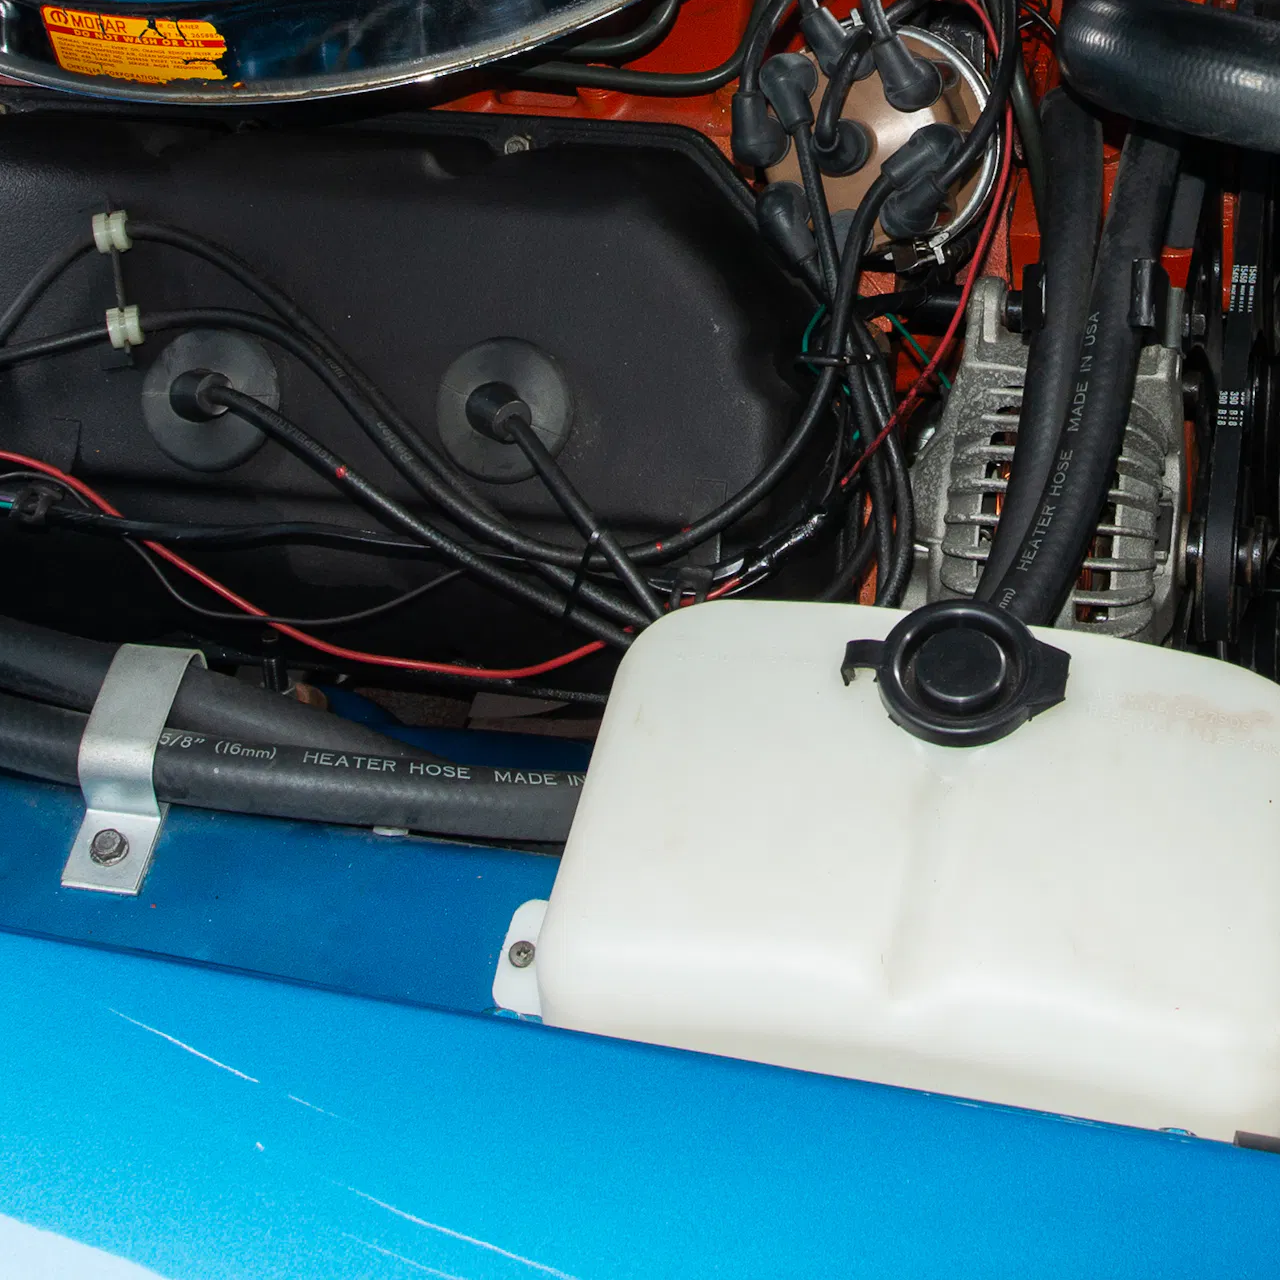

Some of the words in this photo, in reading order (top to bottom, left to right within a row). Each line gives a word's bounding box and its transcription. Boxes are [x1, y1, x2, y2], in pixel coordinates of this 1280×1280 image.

[70, 14, 127, 34] MOPAR
[73, 29, 90, 38] DO
[94, 31, 118, 41] NOT
[123, 35, 158, 45] WASH
[162, 37, 180, 47] OR
[183, 39, 205, 47] OIL
[1017, 499, 1057, 573] HEATER
[1051, 449, 1073, 497] HOSE
[1068, 381, 1089, 432] MADE
[1080, 355, 1092, 375] IN
[1086, 311, 1100, 352] USA
[215, 740, 277, 760] (16mm)
[303, 750, 397, 773] HEATER
[409, 763, 471, 780] HOSE
[494, 770, 557, 786] MADE
